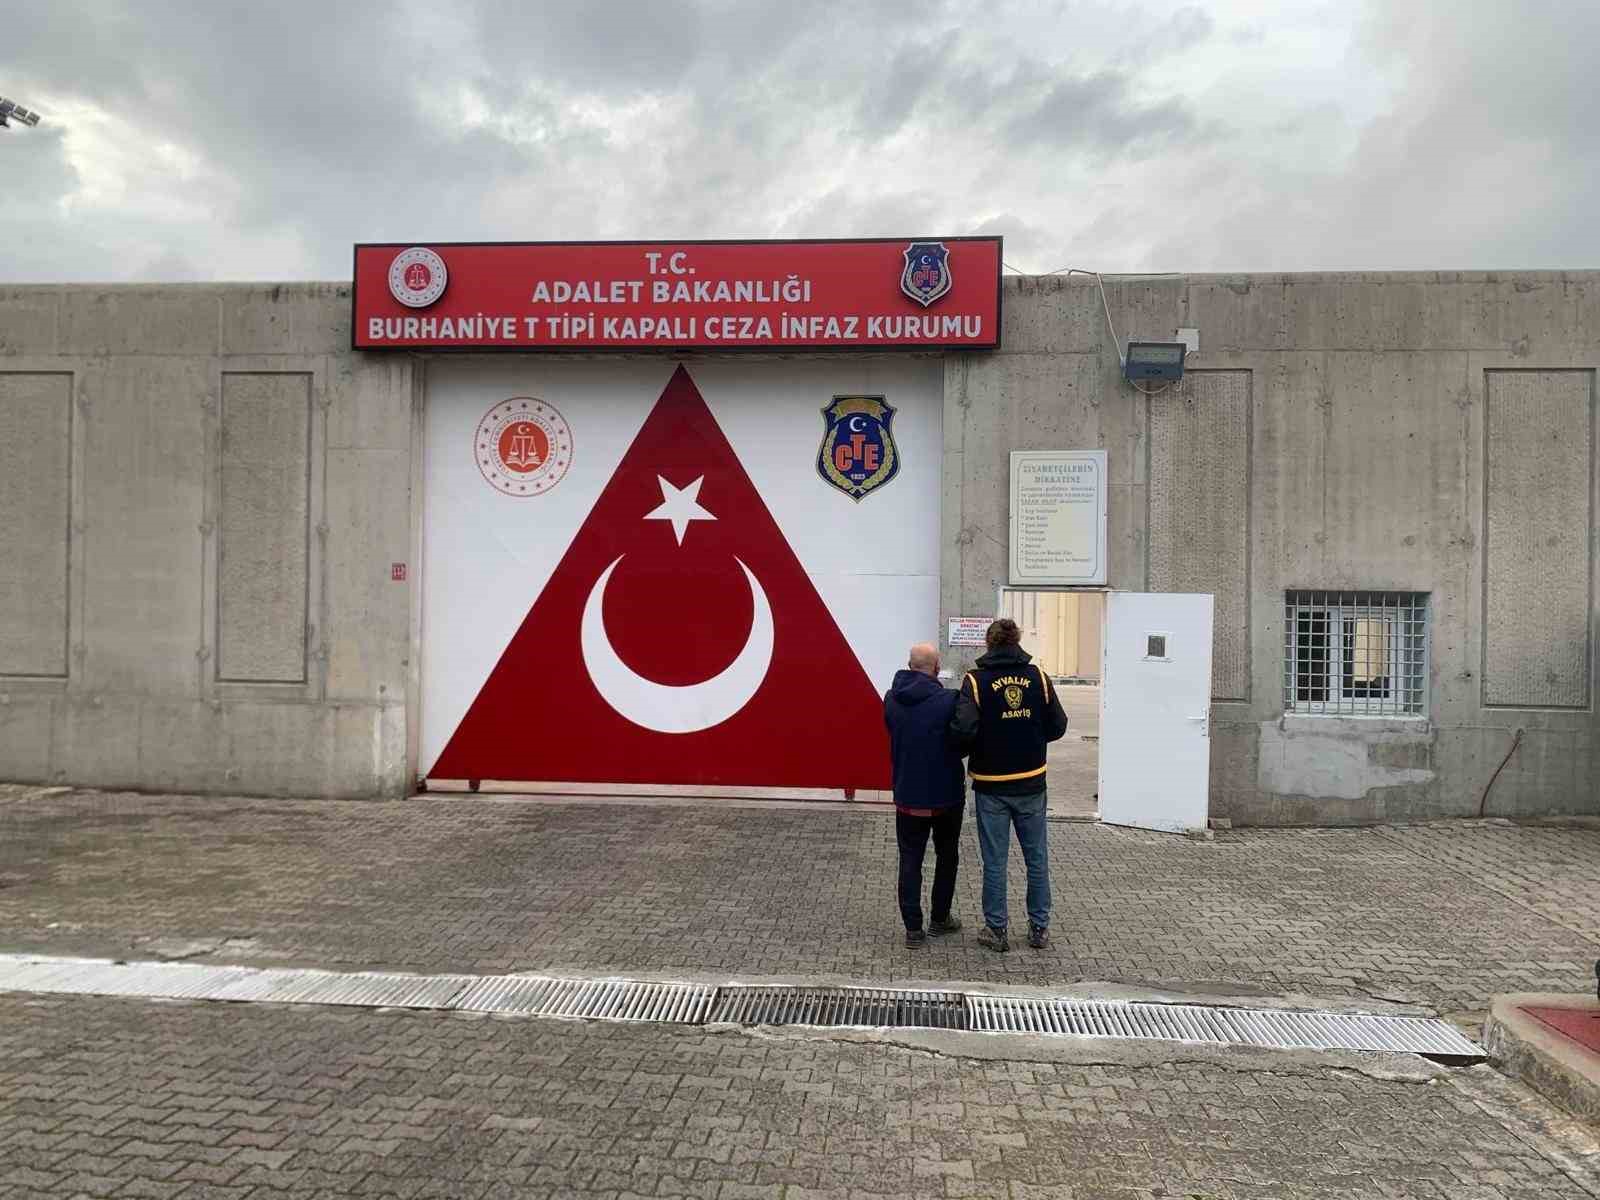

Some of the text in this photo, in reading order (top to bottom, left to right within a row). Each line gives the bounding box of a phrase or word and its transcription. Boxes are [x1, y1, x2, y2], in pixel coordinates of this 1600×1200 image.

[645, 252, 696, 275] T.C.
[532, 274, 811, 303] ADALET BAKANLIĞI
[369, 311, 981, 340] BURHANİYE T TİPİ KAPALI CEZA İNFAZ KURUMU
[835, 434, 879, 471] CTE
[992, 676, 1031, 691] AYVALIK
